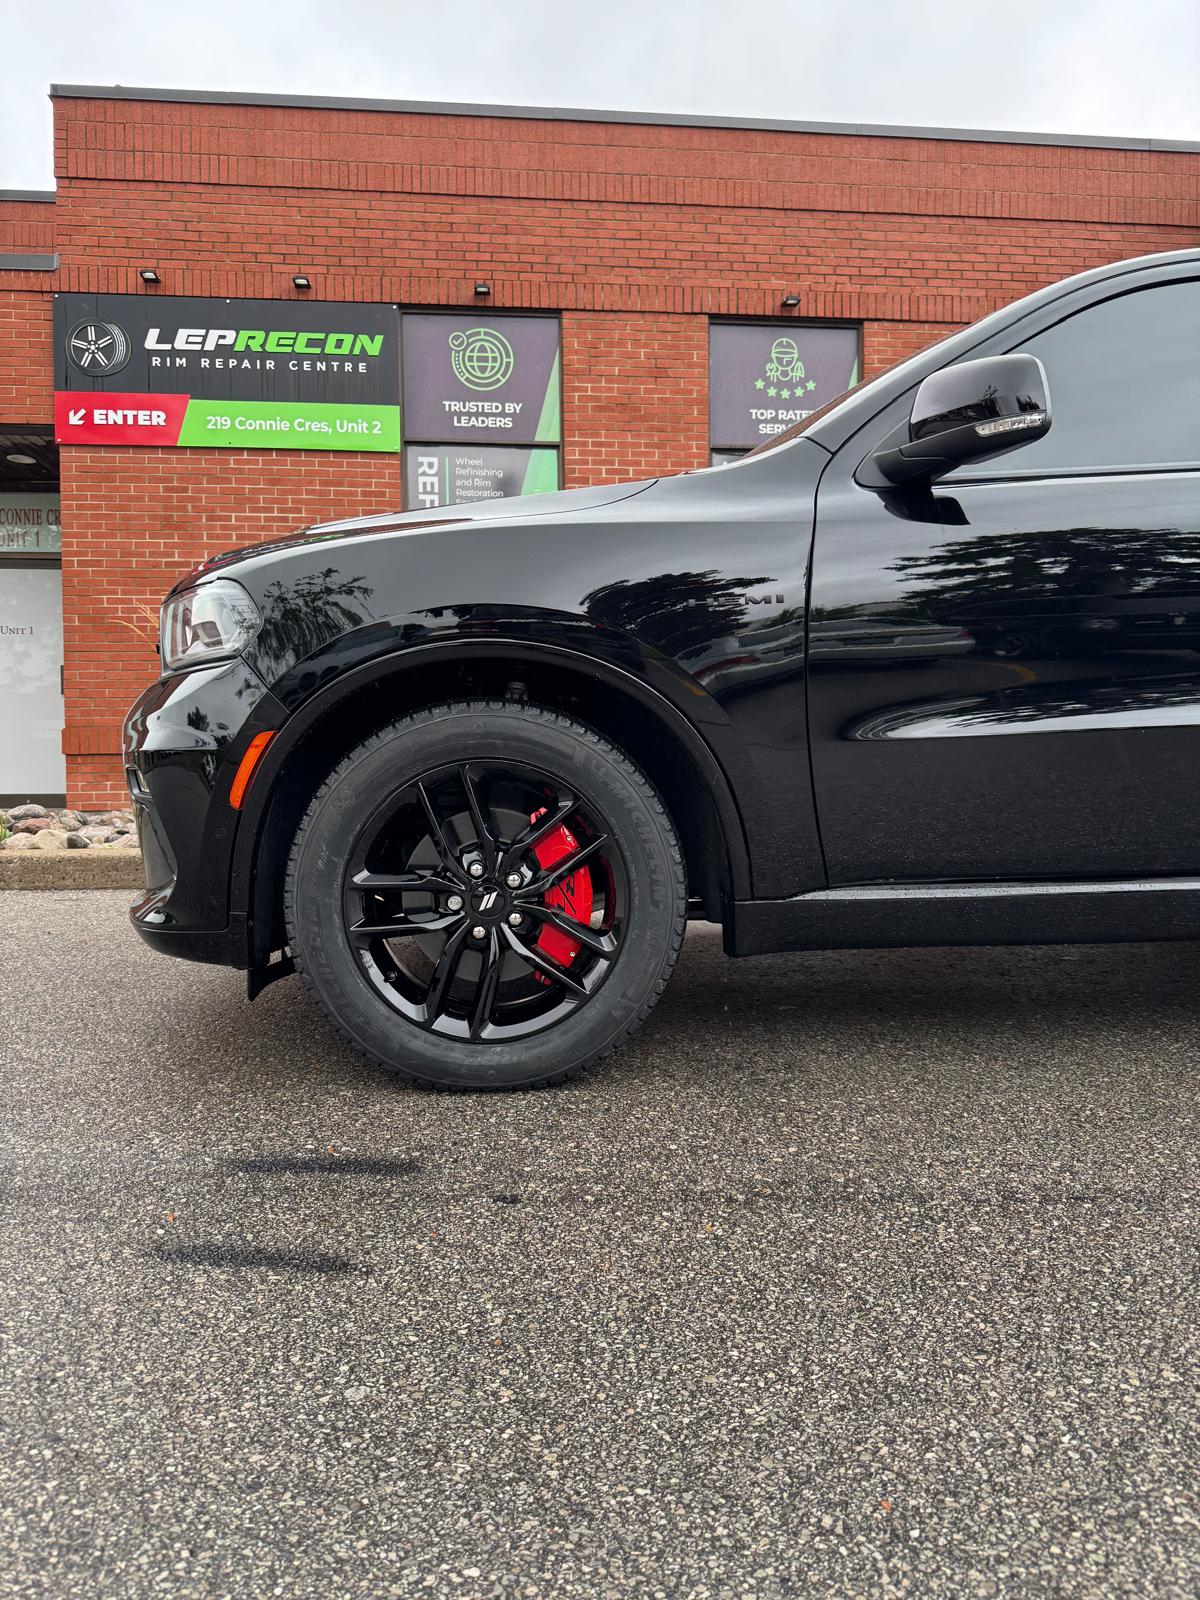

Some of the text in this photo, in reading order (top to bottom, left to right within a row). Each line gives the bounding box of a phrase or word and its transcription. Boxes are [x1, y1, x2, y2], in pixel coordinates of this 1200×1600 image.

[144, 328, 384, 357] LEPRECON
[152, 356, 367, 373] RIM REPAIR CENTRE
[442, 401, 523, 414] TRUSTED BY
[93, 409, 167, 426] ENTER
[749, 409, 814, 421] TOP RATE
[206, 416, 382, 435] 219 Connie Cres, Unit 2
[453, 416, 513, 428] LEADERS
[455, 457, 483, 466] Wheel
[455, 467, 504, 478] Refinishing
[455, 478, 492, 487] and Rim
[455, 488, 504, 498] Restoration
[0, 508, 43, 525] CONNIE
[29, 625, 34, 635] 1
